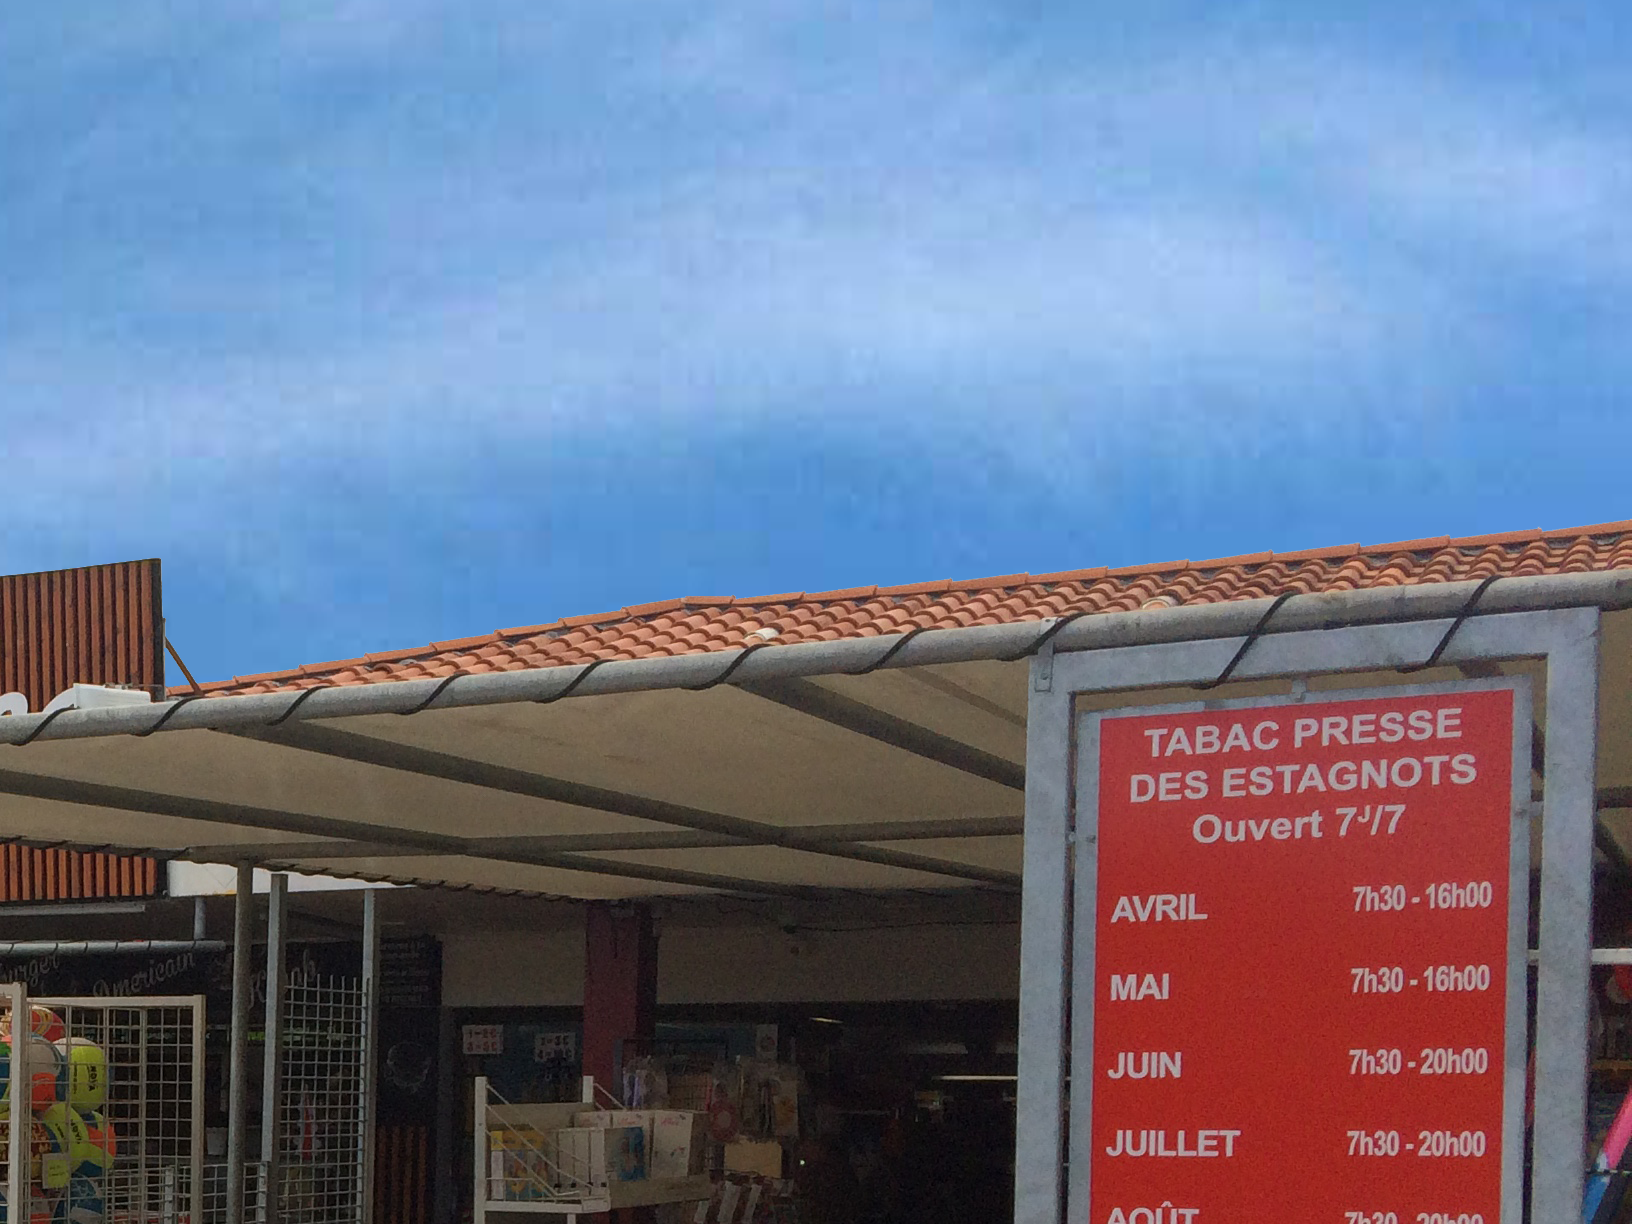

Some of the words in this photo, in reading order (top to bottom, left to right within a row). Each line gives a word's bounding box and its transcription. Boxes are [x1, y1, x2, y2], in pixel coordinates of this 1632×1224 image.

[1144, 721, 1279, 757] TABAC
[1294, 708, 1462, 748] PRESSE
[1131, 770, 1208, 802] DES
[1223, 754, 1476, 797] ESTAGNOTS
[1193, 810, 1322, 843] Ouvert
[1111, 894, 1208, 922] AVRIL
[1111, 973, 1169, 1000] MAI
[1108, 1052, 1181, 1078] JUIN
[1106, 1130, 1240, 1156] JUILLET
